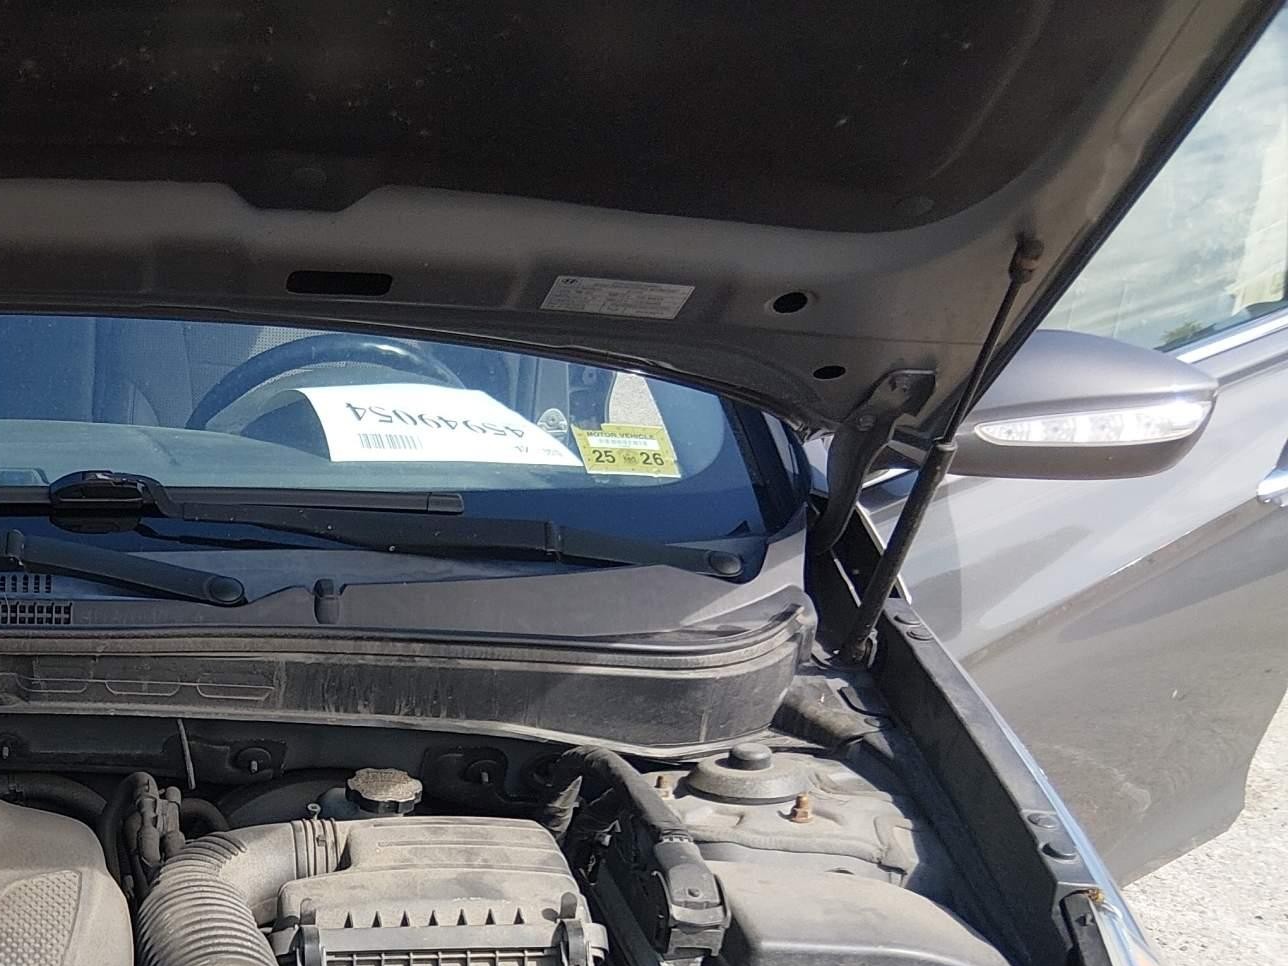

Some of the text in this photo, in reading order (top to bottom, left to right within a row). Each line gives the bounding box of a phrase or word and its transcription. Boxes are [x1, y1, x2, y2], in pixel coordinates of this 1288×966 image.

[345, 402, 525, 438] 45949054
[592, 449, 616, 464] 25
[640, 451, 665, 466] 26
